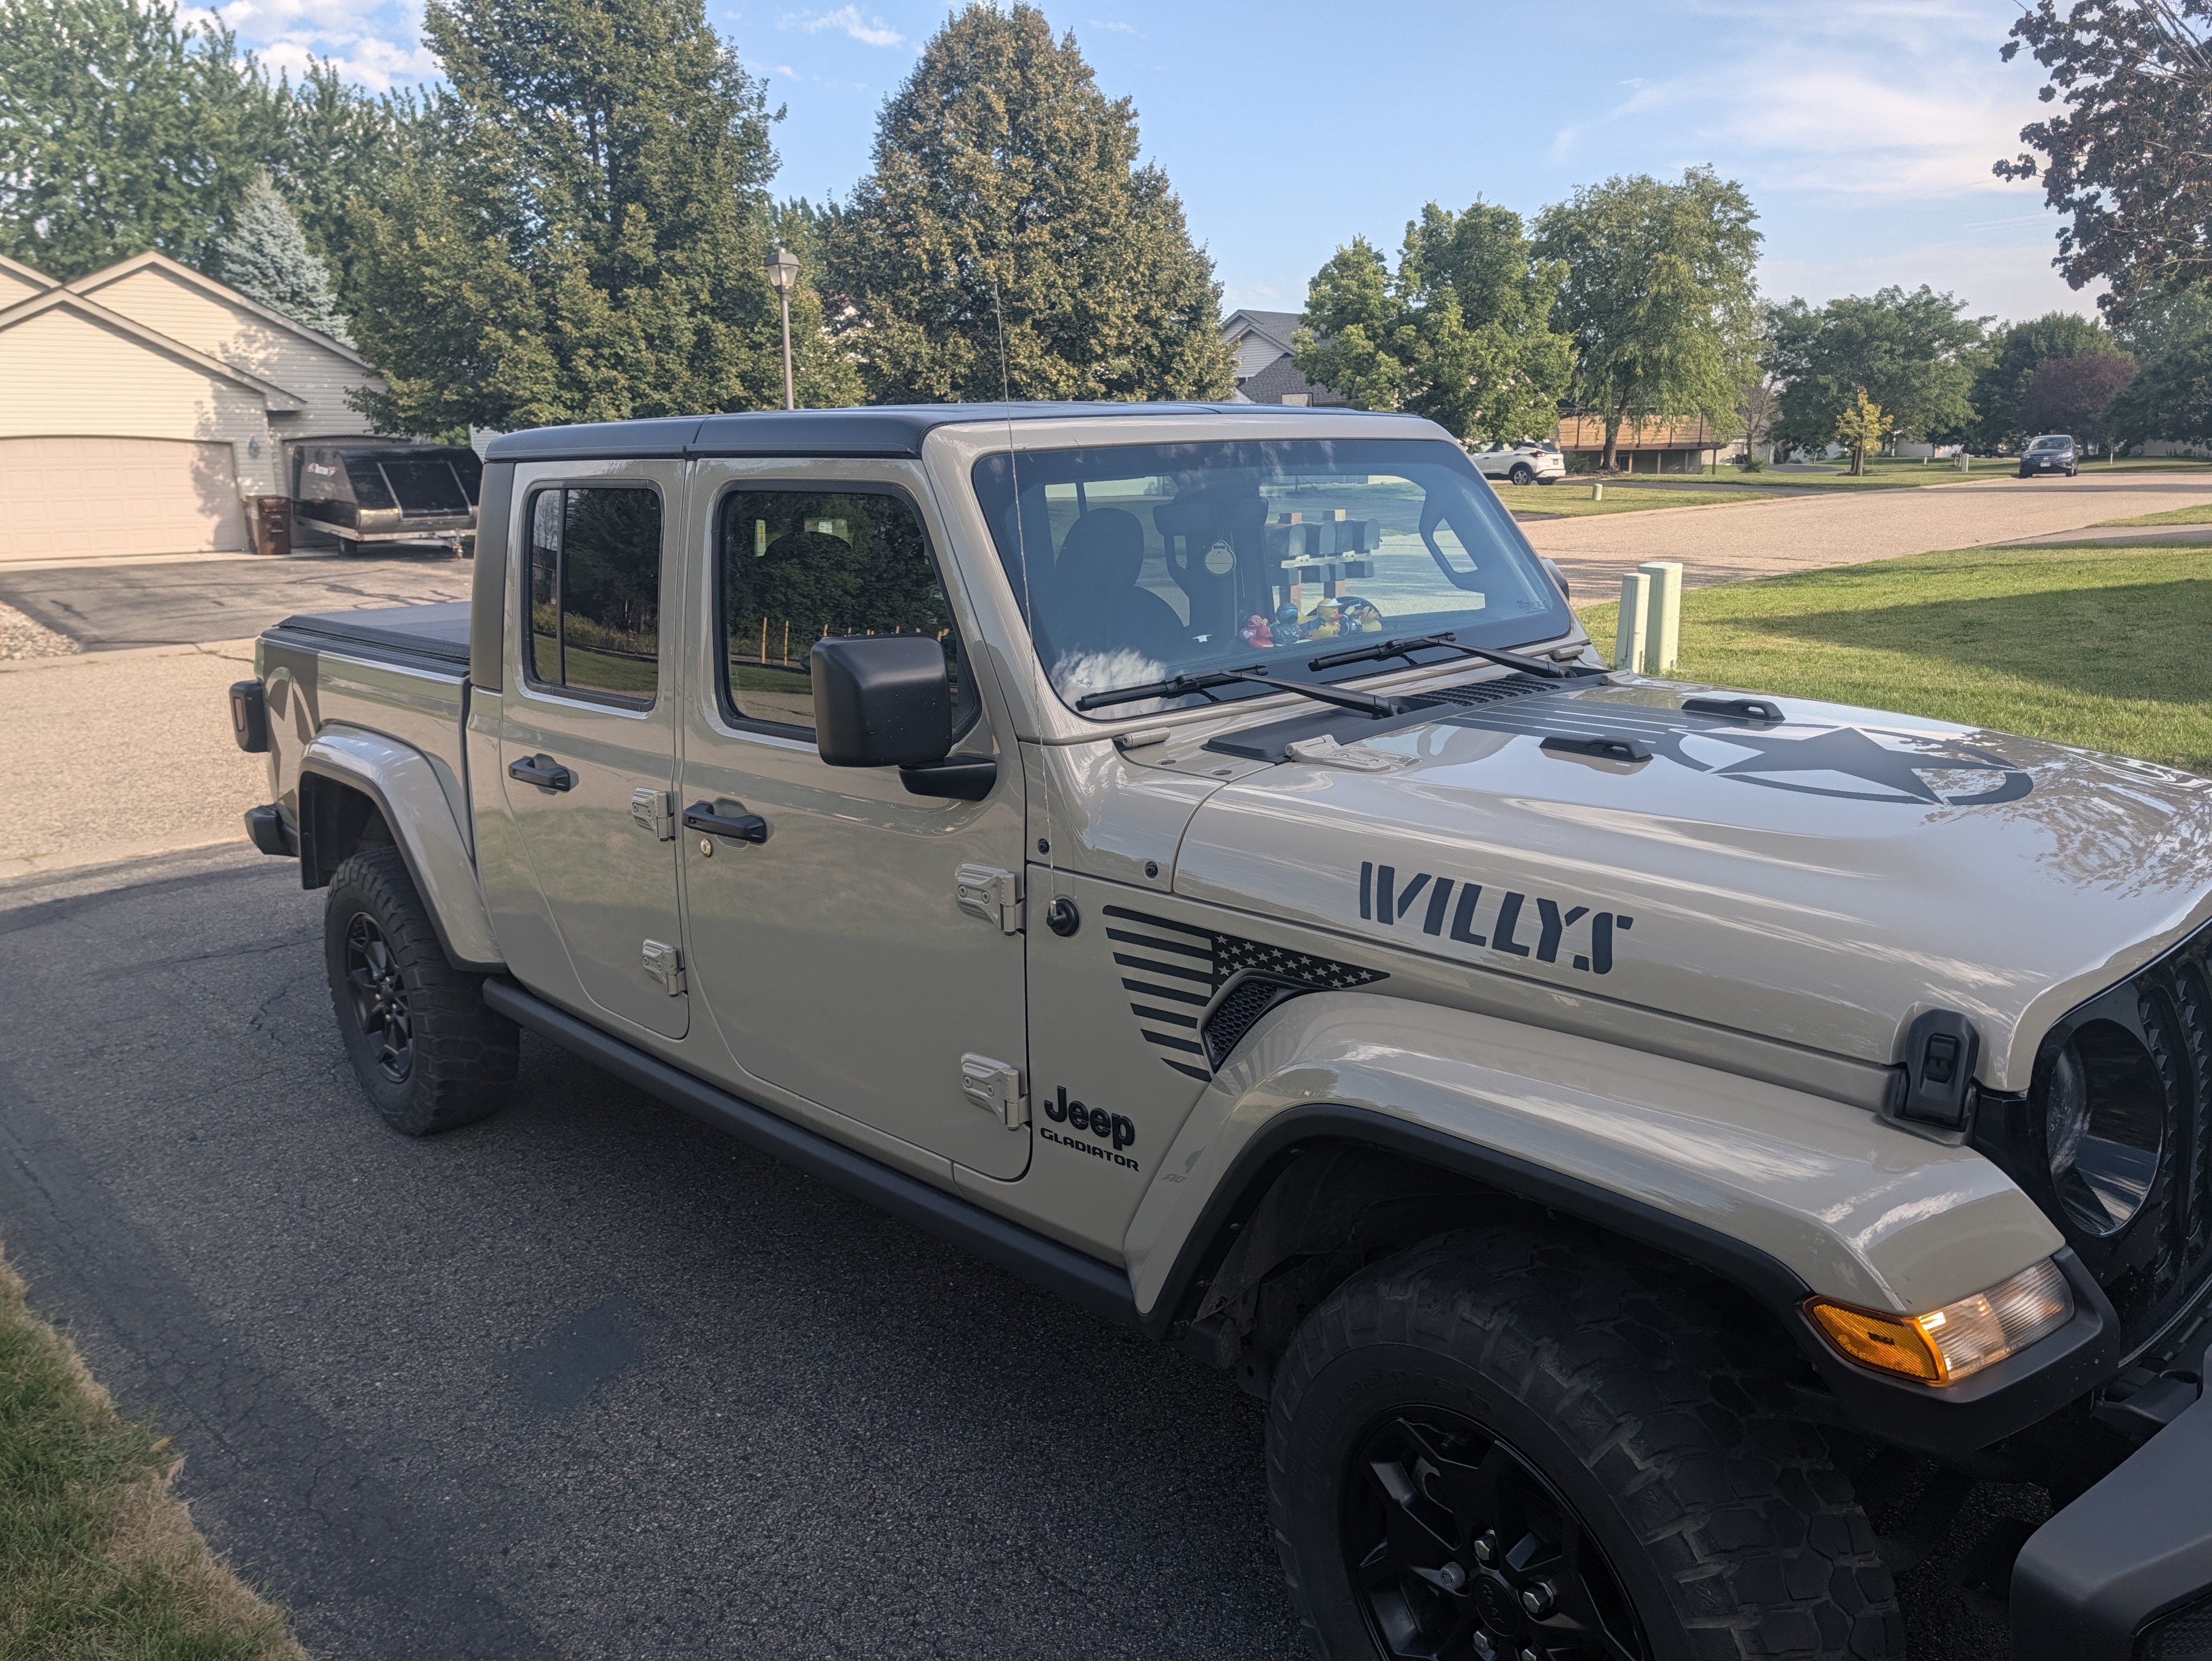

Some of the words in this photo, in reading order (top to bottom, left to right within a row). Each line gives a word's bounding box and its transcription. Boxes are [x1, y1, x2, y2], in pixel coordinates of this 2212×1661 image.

[1360, 861, 1634, 975] WILLYS
[1040, 1127, 1140, 1172] GLADIATOR
[1044, 1085, 1135, 1151] Jeep
